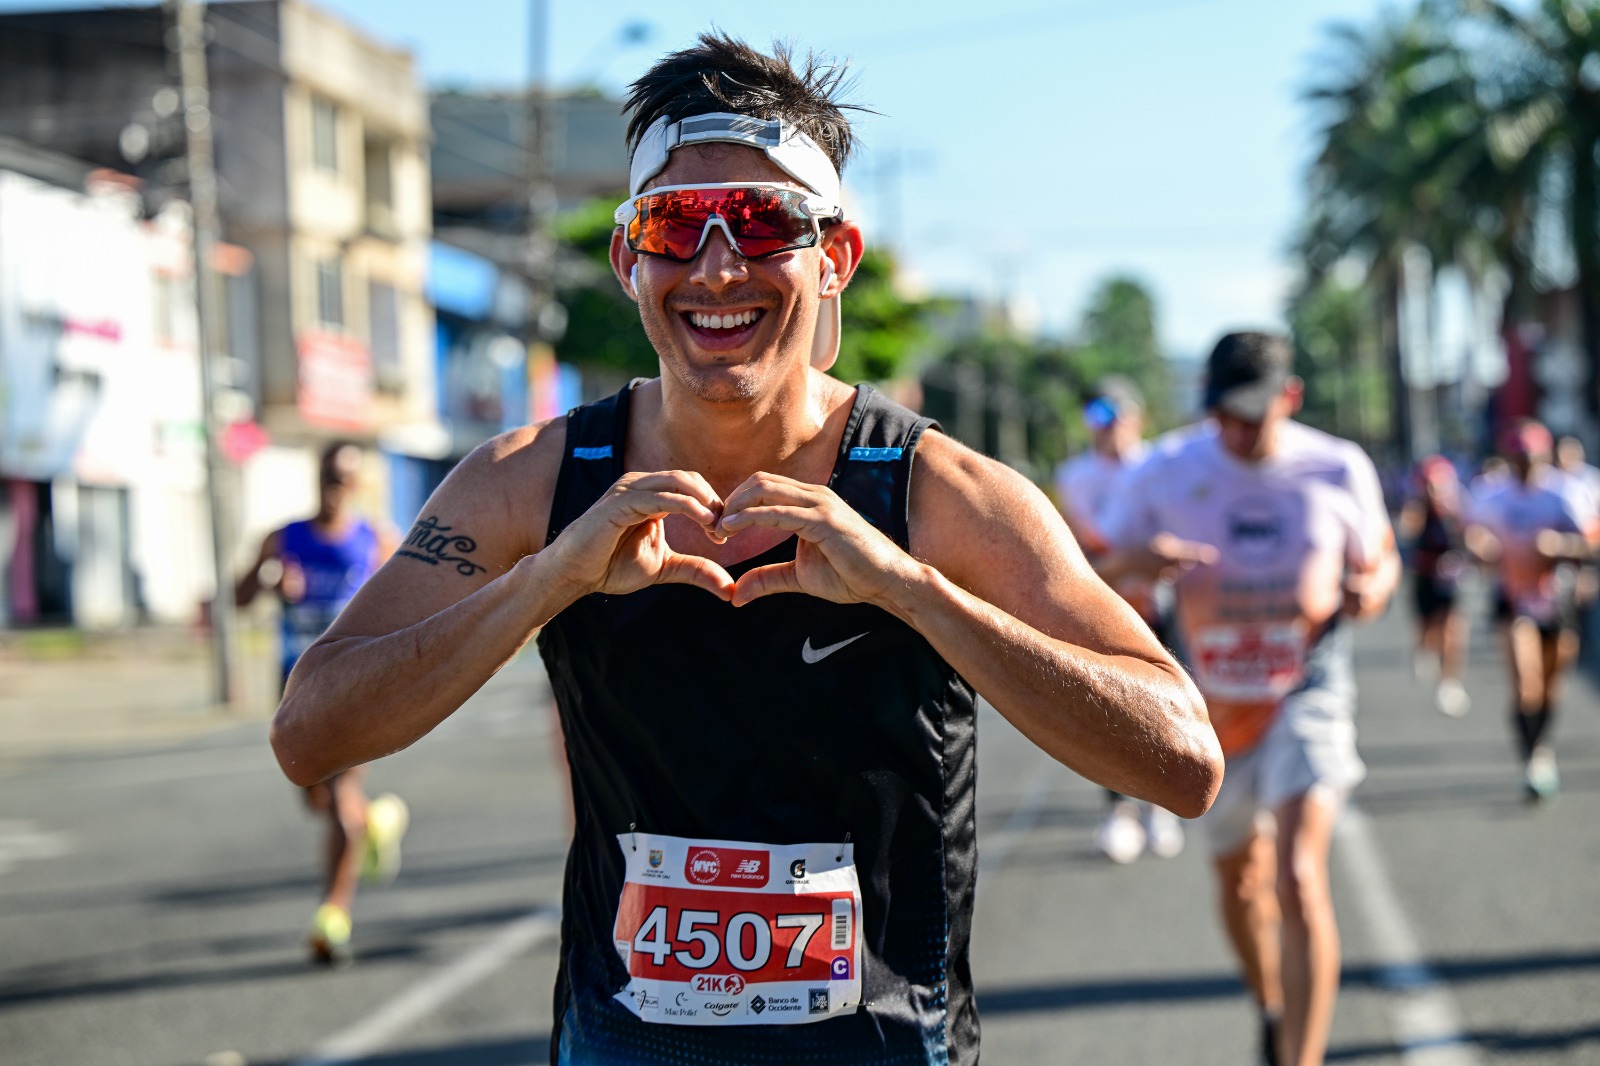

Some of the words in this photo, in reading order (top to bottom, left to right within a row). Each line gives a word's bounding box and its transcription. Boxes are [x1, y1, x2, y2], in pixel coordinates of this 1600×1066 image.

[790, 858, 806, 878] G
[634, 906, 825, 971] 4507
[833, 960, 847, 975] C
[696, 976, 723, 992] 21K
[704, 1001, 740, 1010] Colgate
[768, 1004, 802, 1012] Occidente
